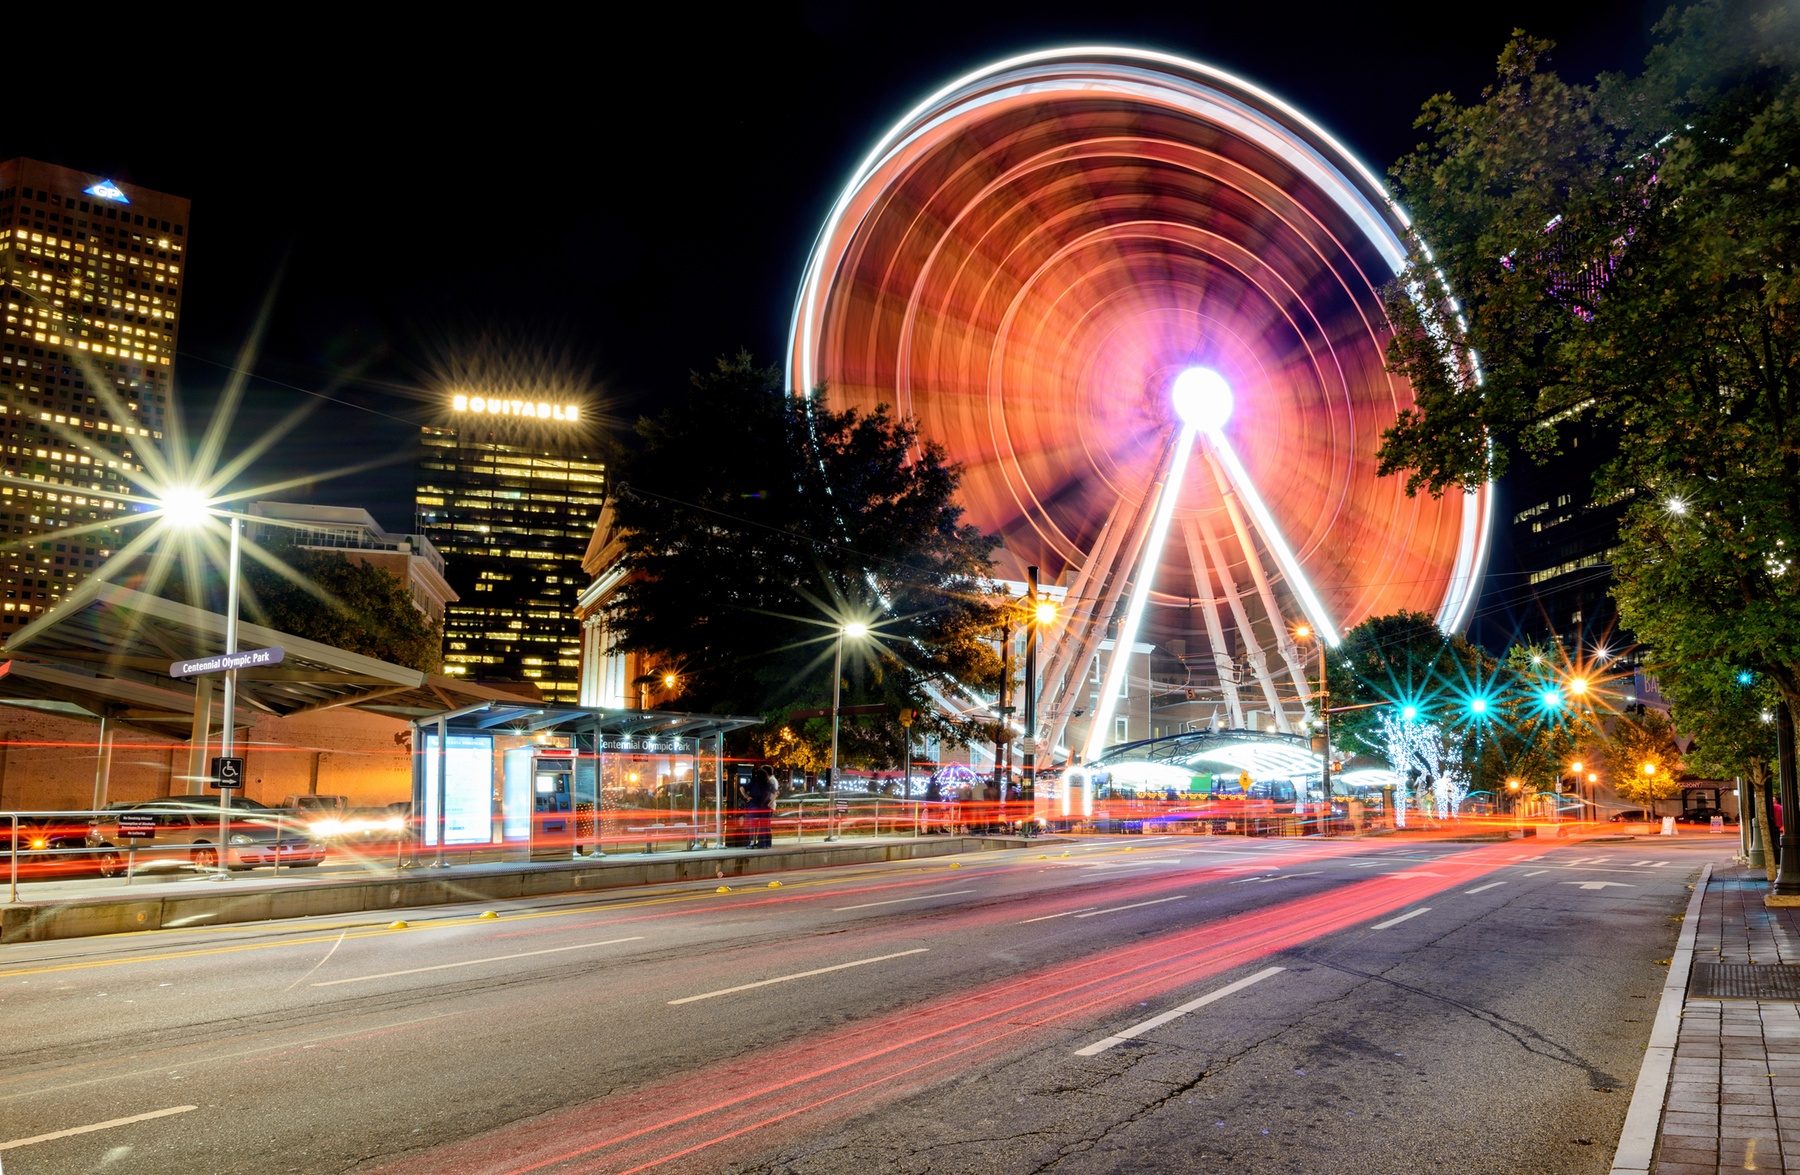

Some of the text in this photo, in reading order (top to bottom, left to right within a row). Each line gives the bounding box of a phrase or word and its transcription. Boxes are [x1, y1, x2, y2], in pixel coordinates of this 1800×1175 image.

[93, 185, 121, 199] GP
[453, 395, 579, 421] EQUITABLE
[183, 652, 270, 673] Centennial Olympic Park
[642, 741, 673, 752] Olympic
[674, 741, 690, 751] Park
